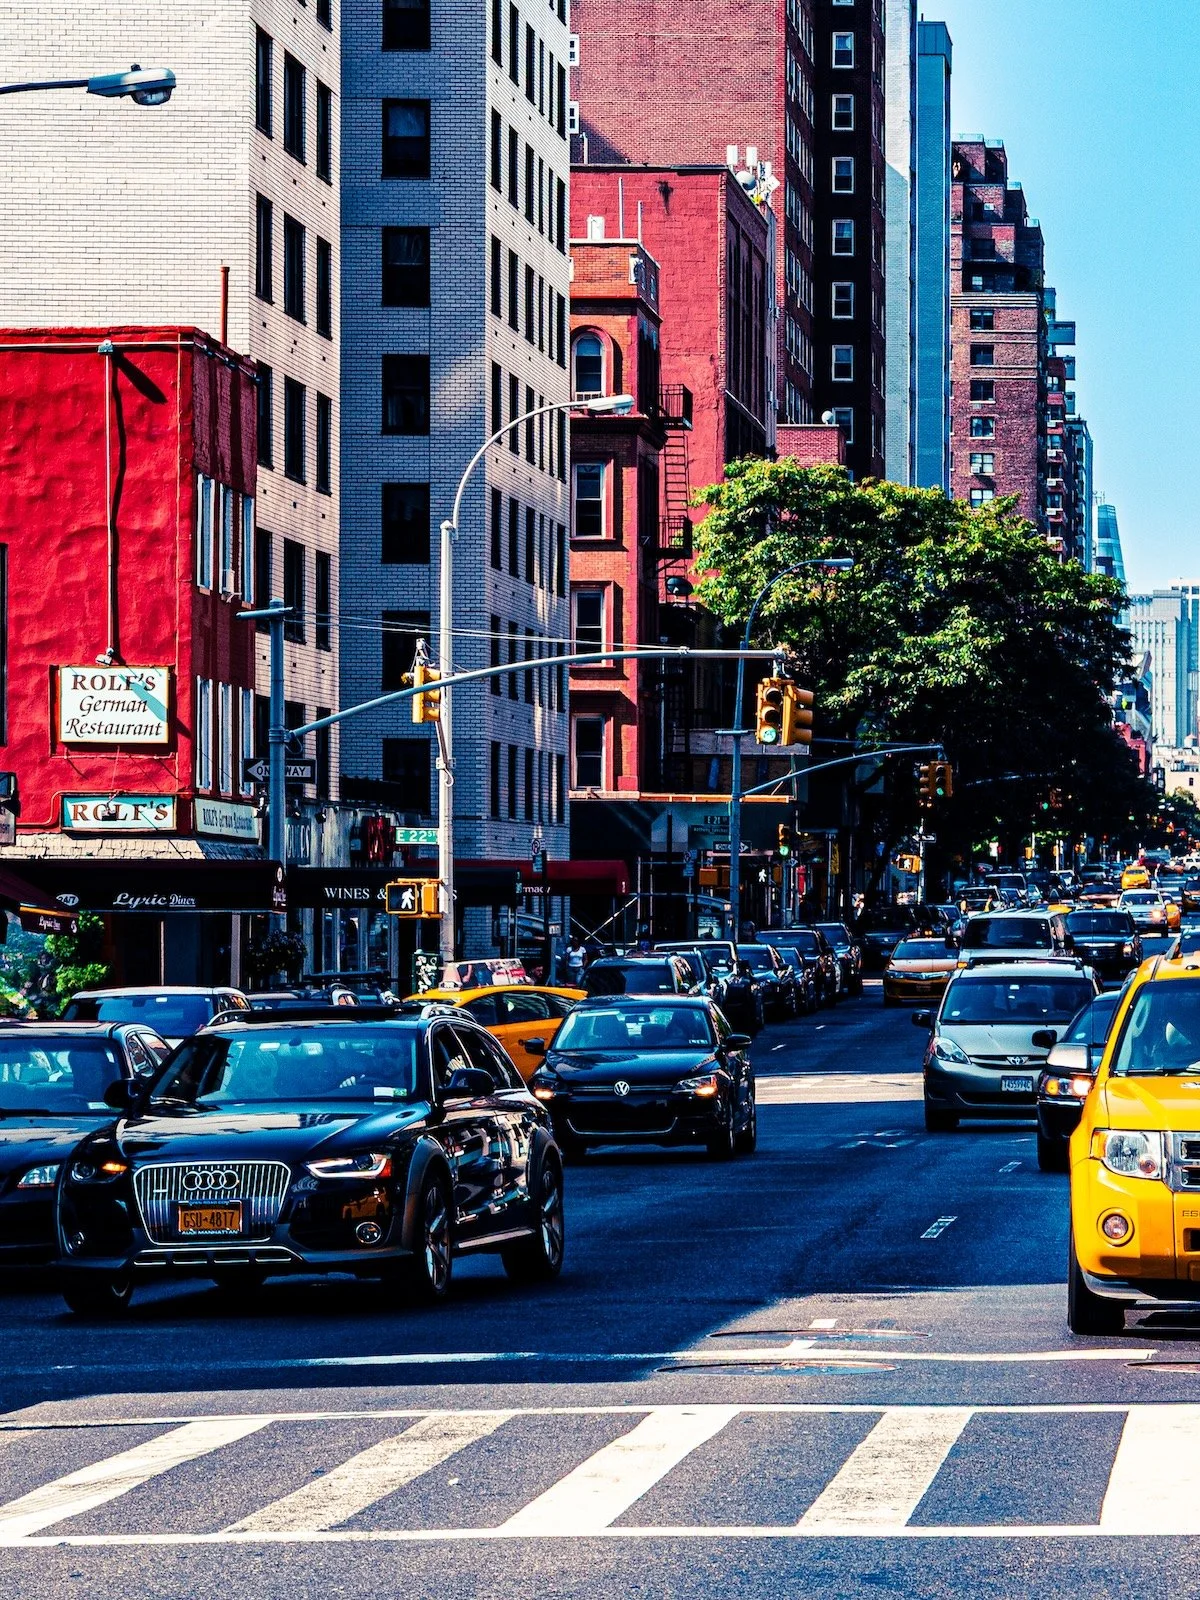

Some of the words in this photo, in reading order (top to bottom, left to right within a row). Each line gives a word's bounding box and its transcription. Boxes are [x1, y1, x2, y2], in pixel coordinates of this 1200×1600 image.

[72, 673, 156, 691] ROLF'S
[79, 695, 148, 717] German
[65, 718, 162, 738] Restaurant
[257, 766, 271, 776] ON
[396, 830, 405, 842] E
[409, 830, 428, 842] 22
[113, 892, 167, 908] Lyric
[169, 893, 196, 907] Diner
[325, 887, 370, 899] WINES
